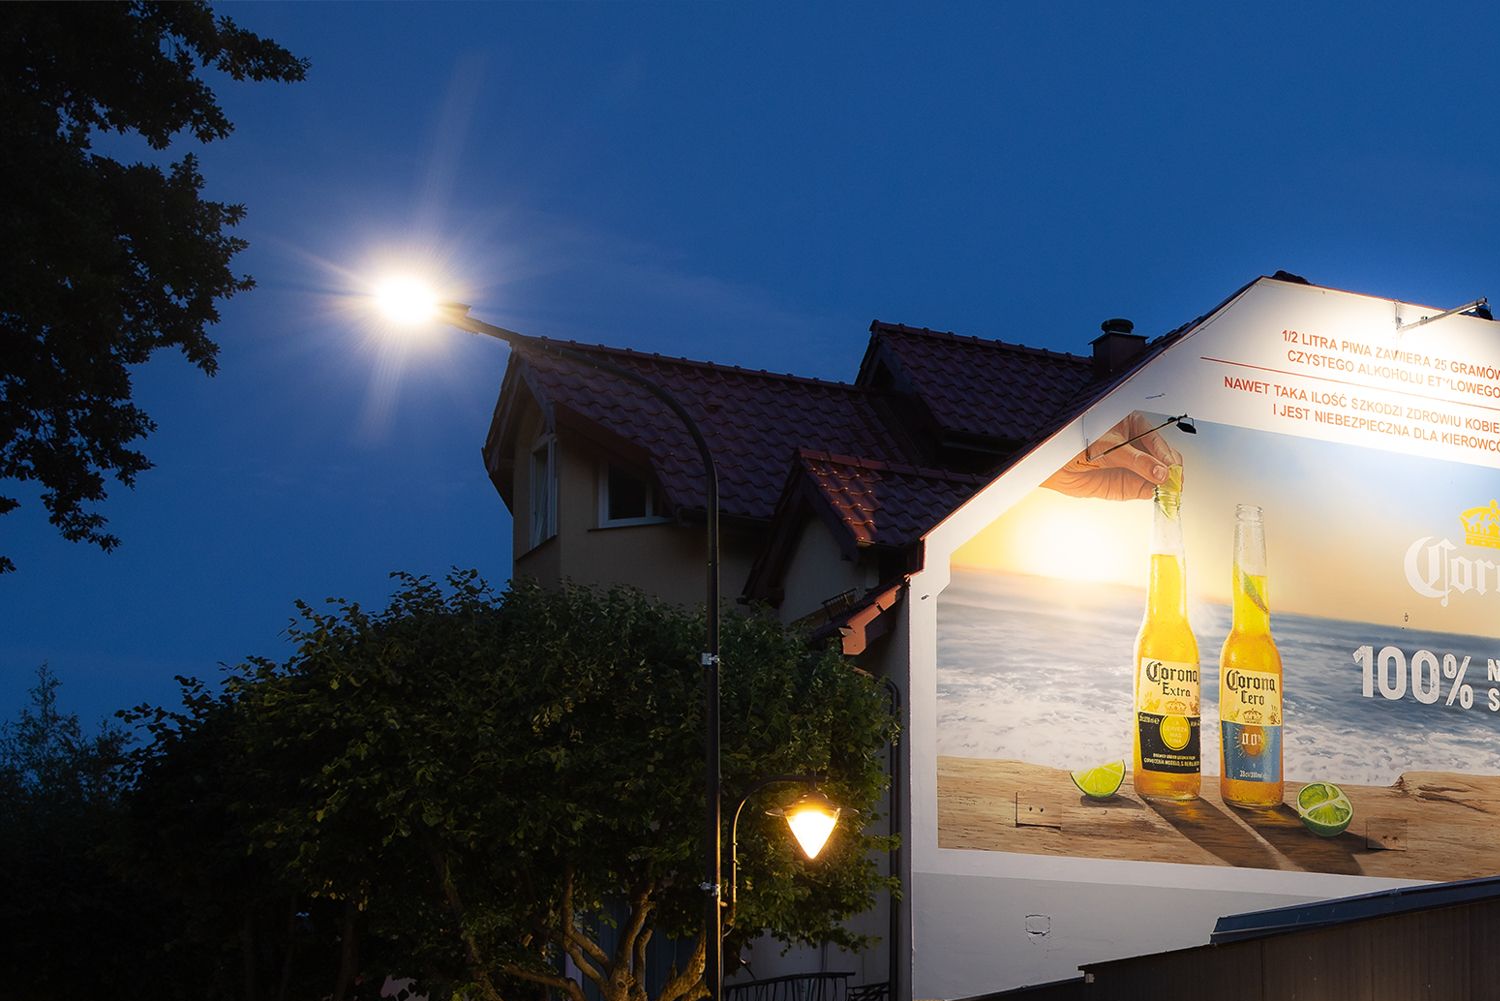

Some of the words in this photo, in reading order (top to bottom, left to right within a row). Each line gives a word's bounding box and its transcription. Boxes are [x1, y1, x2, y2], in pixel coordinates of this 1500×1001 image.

[1281, 329, 1298, 343] 1/2
[1302, 333, 1338, 351] LITRA
[1342, 341, 1373, 358] PIWA
[1377, 347, 1431, 367] ZAWIERA
[1435, 358, 1448, 371] 25
[1287, 350, 1354, 373] CZYSTEGO
[1358, 363, 1423, 385] ALKOHOLU
[1224, 376, 1270, 396] NAWET
[1274, 384, 1308, 402] TAKA
[1311, 391, 1347, 408] ILOŚĆ
[1351, 398, 1403, 417] SZKODZI
[1406, 407, 1462, 428] ZDROWIU
[1280, 405, 1311, 421] JEST
[1315, 410, 1410, 436] NIEBEZPIECZNA
[1413, 427, 1439, 443] DLA
[1146, 660, 1199, 686] Corona
[1162, 682, 1191, 697] Extra
[1226, 669, 1277, 694] Corona
[1352, 645, 1473, 710] 100%
[1240, 691, 1265, 706] Cero
